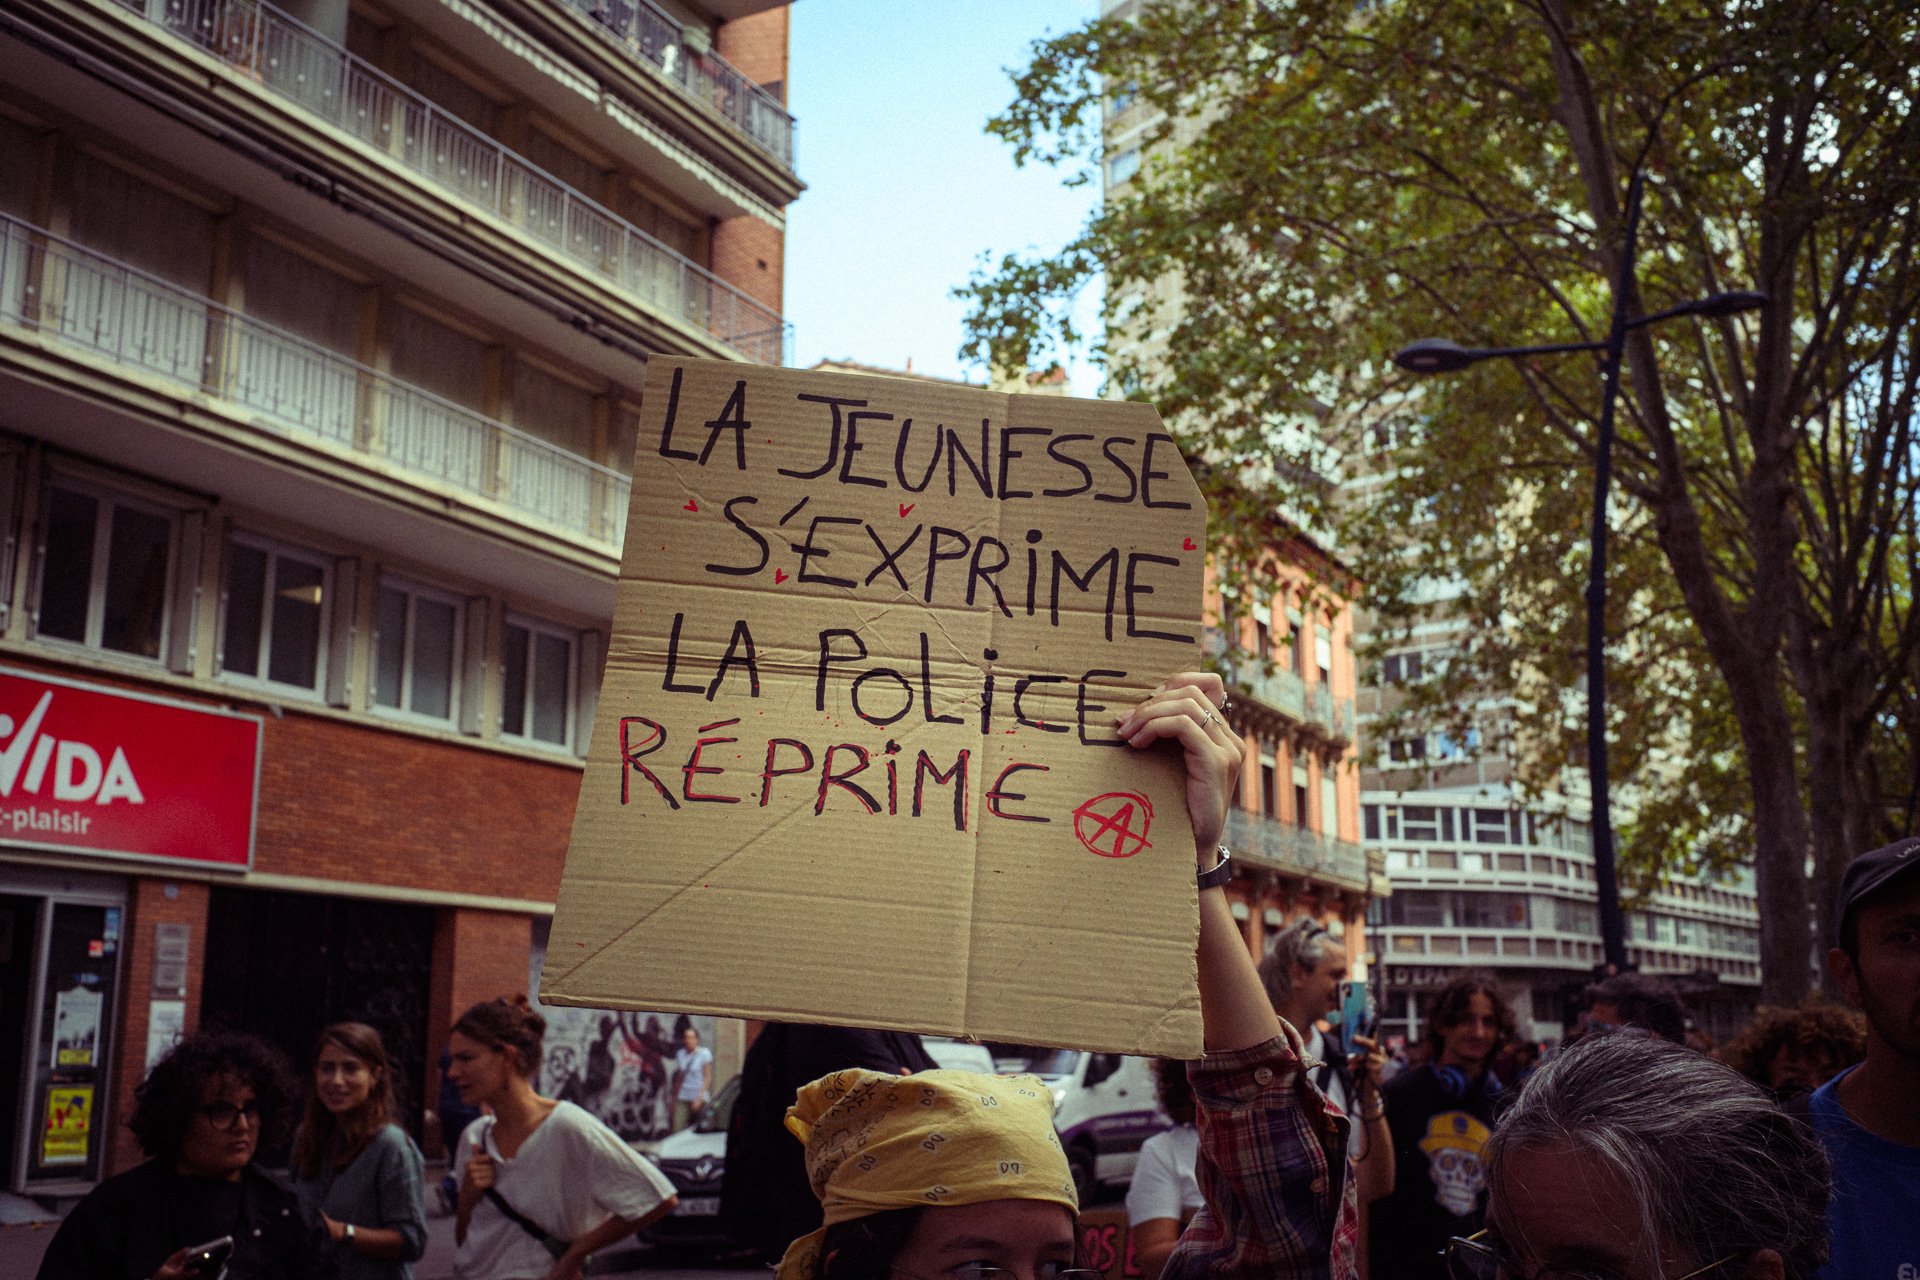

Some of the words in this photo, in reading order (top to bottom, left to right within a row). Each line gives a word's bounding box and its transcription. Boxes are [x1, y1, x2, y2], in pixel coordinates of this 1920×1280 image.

[657, 366, 753, 471] LA
[776, 392, 1193, 510] JEUNESSE
[661, 612, 761, 702] LA
[0, 806, 92, 835] -plaisir
